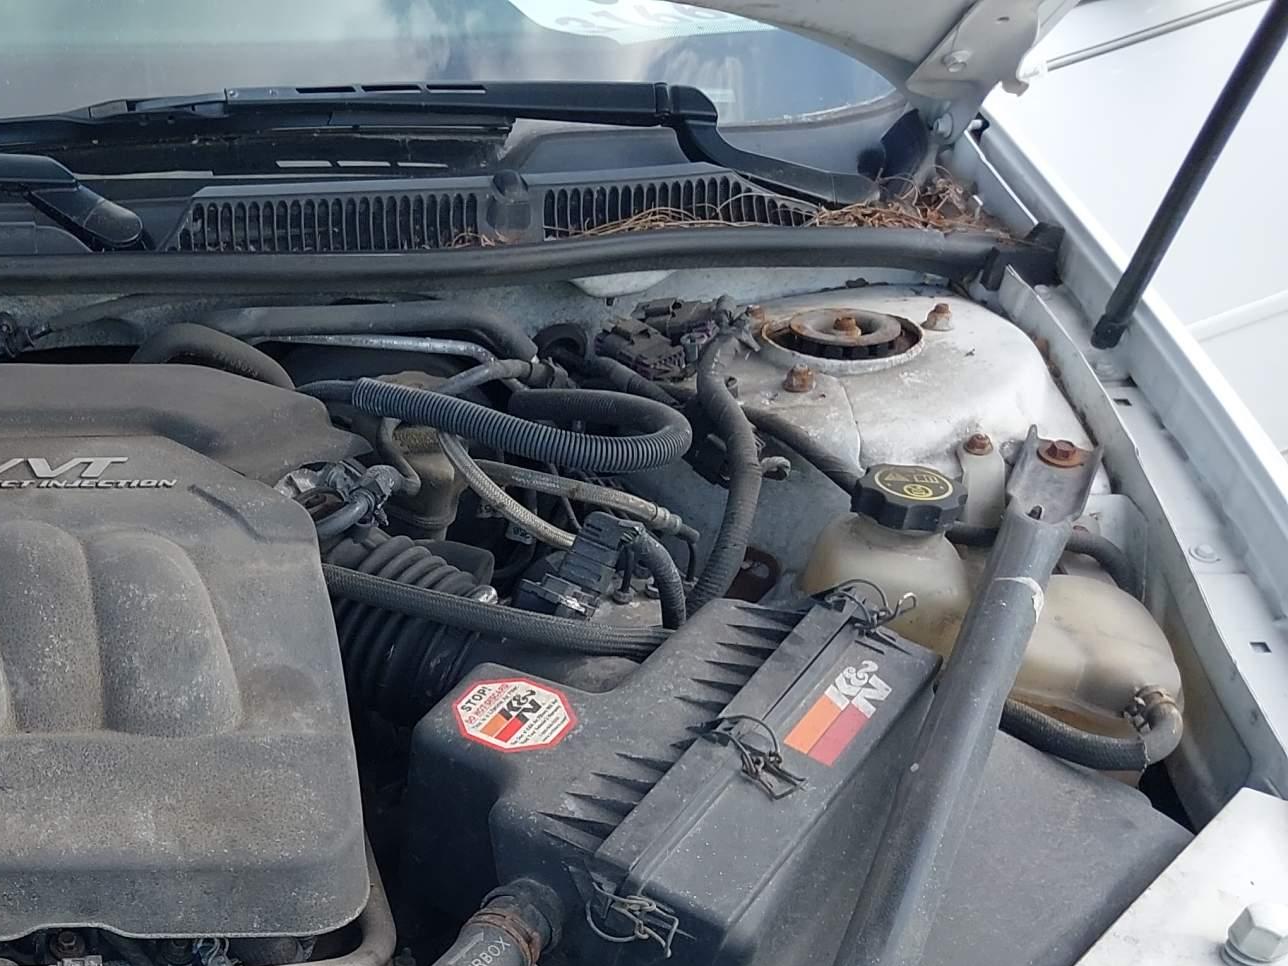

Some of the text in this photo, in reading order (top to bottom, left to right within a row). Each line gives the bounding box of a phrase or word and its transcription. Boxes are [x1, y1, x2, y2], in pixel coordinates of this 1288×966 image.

[38, 478, 178, 489] INJECTION
[461, 685, 492, 713] STOP!
[824, 660, 892, 719] K&N
